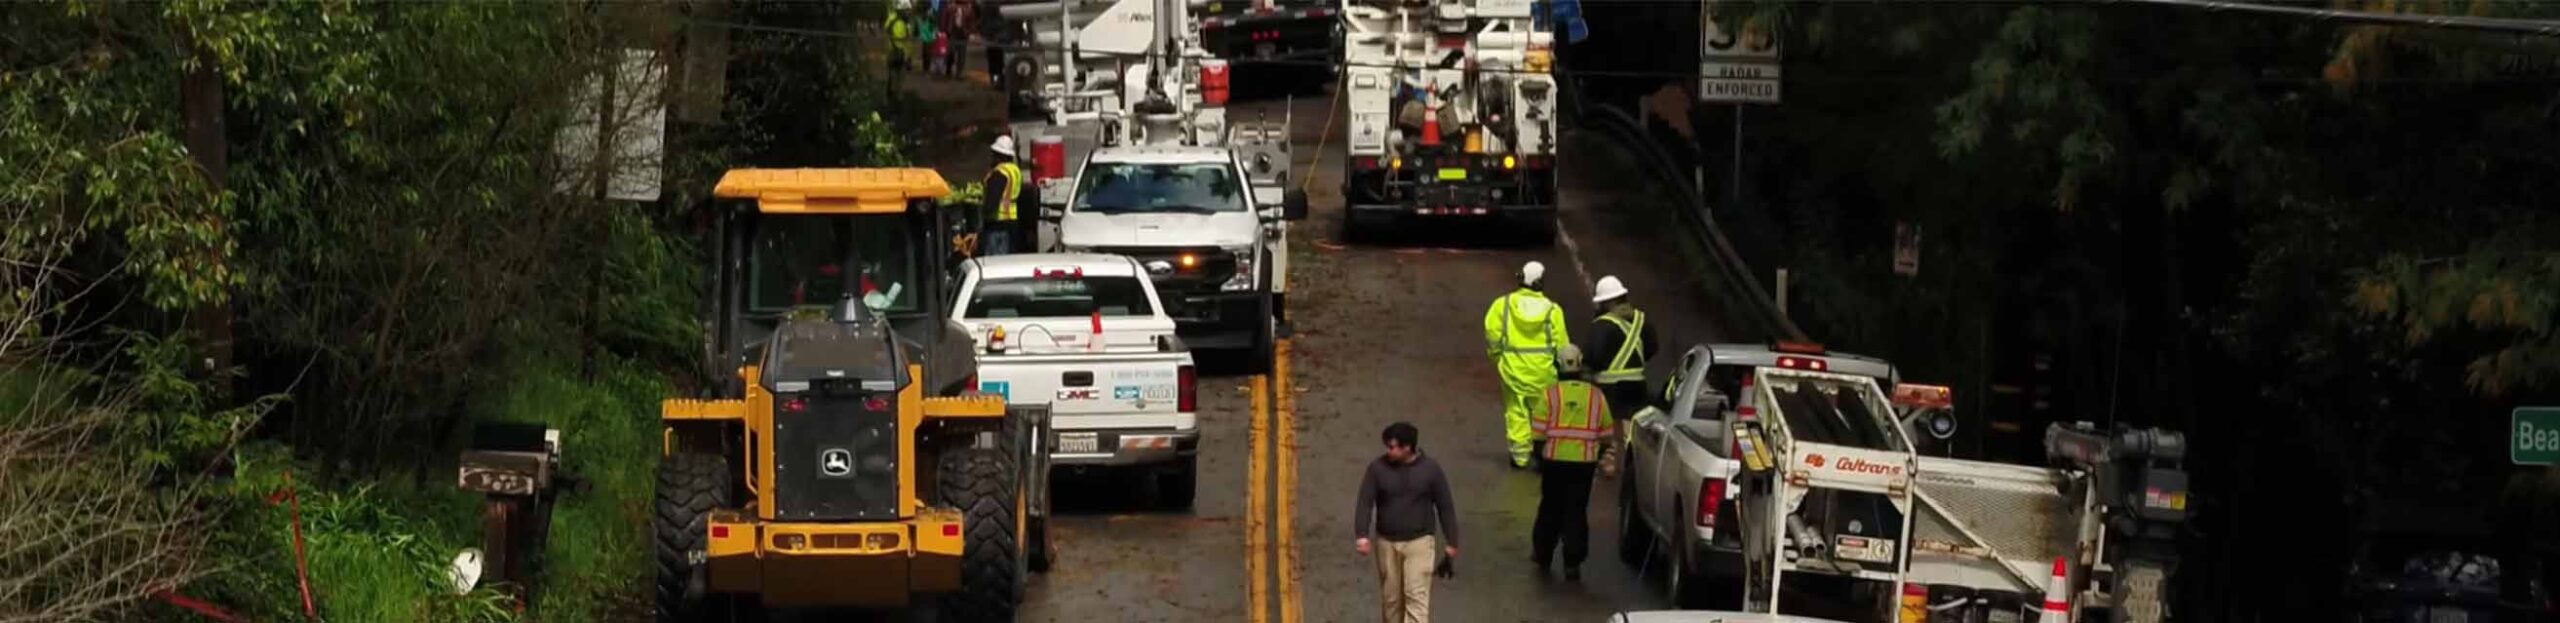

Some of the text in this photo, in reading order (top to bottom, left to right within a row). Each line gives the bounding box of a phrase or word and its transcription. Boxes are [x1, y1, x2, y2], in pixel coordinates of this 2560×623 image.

[1720, 66, 1762, 79] RADAR
[1707, 81, 1774, 97] ENFORCED
[1056, 390, 1100, 401] GMC
[2519, 421, 2560, 451] Bea
[1836, 456, 1904, 475] Caltrans
